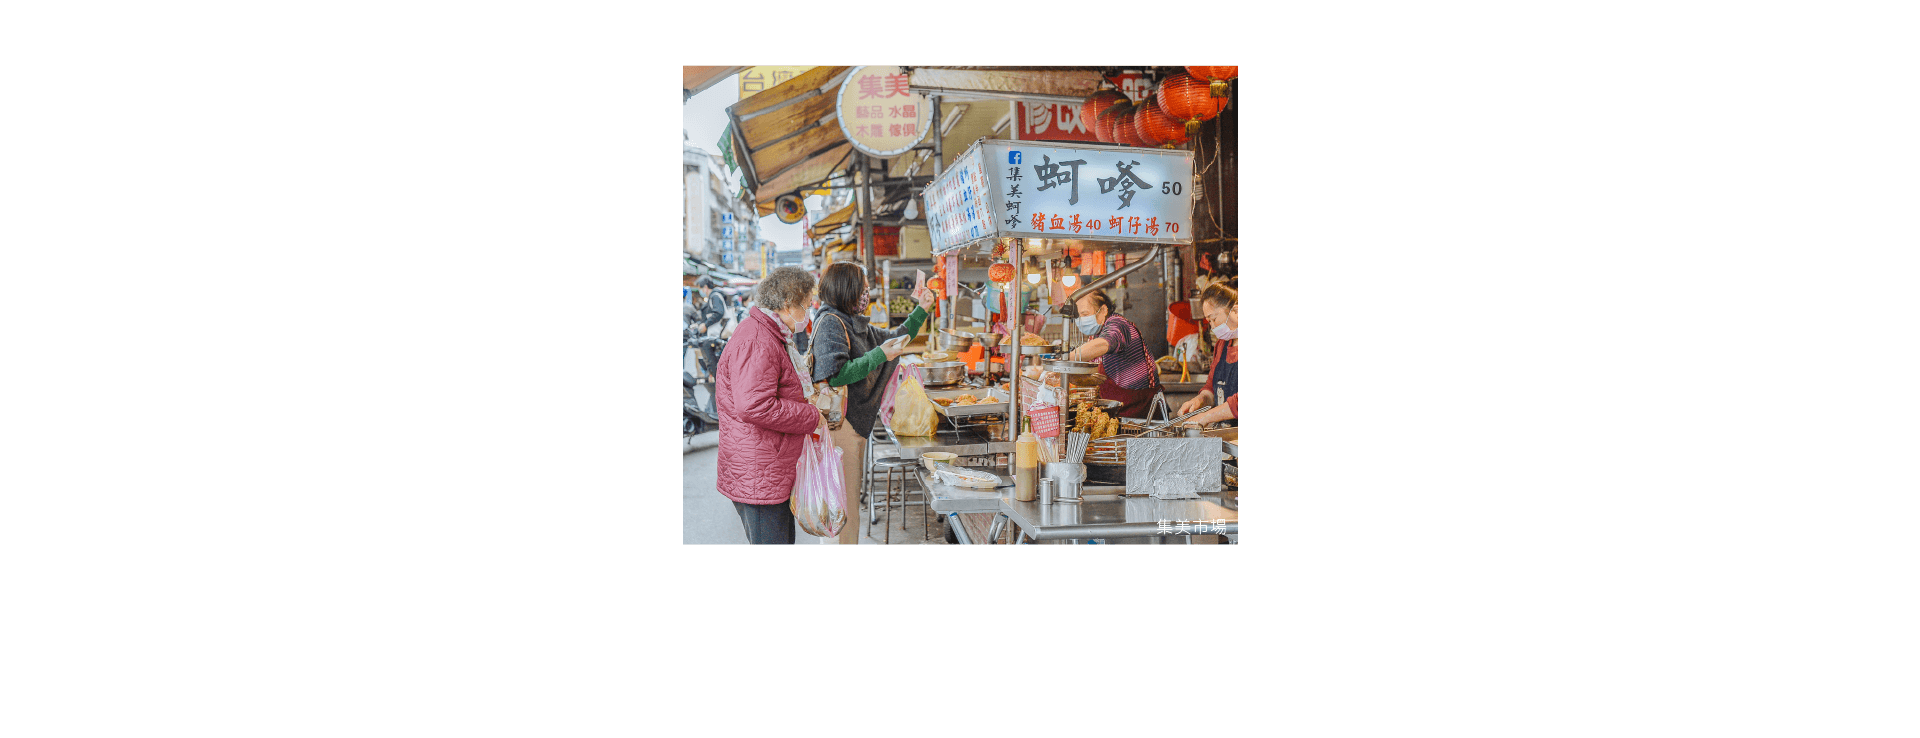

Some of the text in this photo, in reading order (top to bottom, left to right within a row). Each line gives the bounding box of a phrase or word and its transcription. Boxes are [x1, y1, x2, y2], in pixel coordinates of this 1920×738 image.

[857, 72, 911, 101] 集美
[888, 104, 917, 119] 水晶
[1033, 153, 1154, 211] 蚵嗲
[1161, 181, 1183, 196] 50
[1004, 166, 1023, 230] 集美蚵嗲
[1030, 211, 1180, 237] 豬血湯 40 蚵仔湯 70
